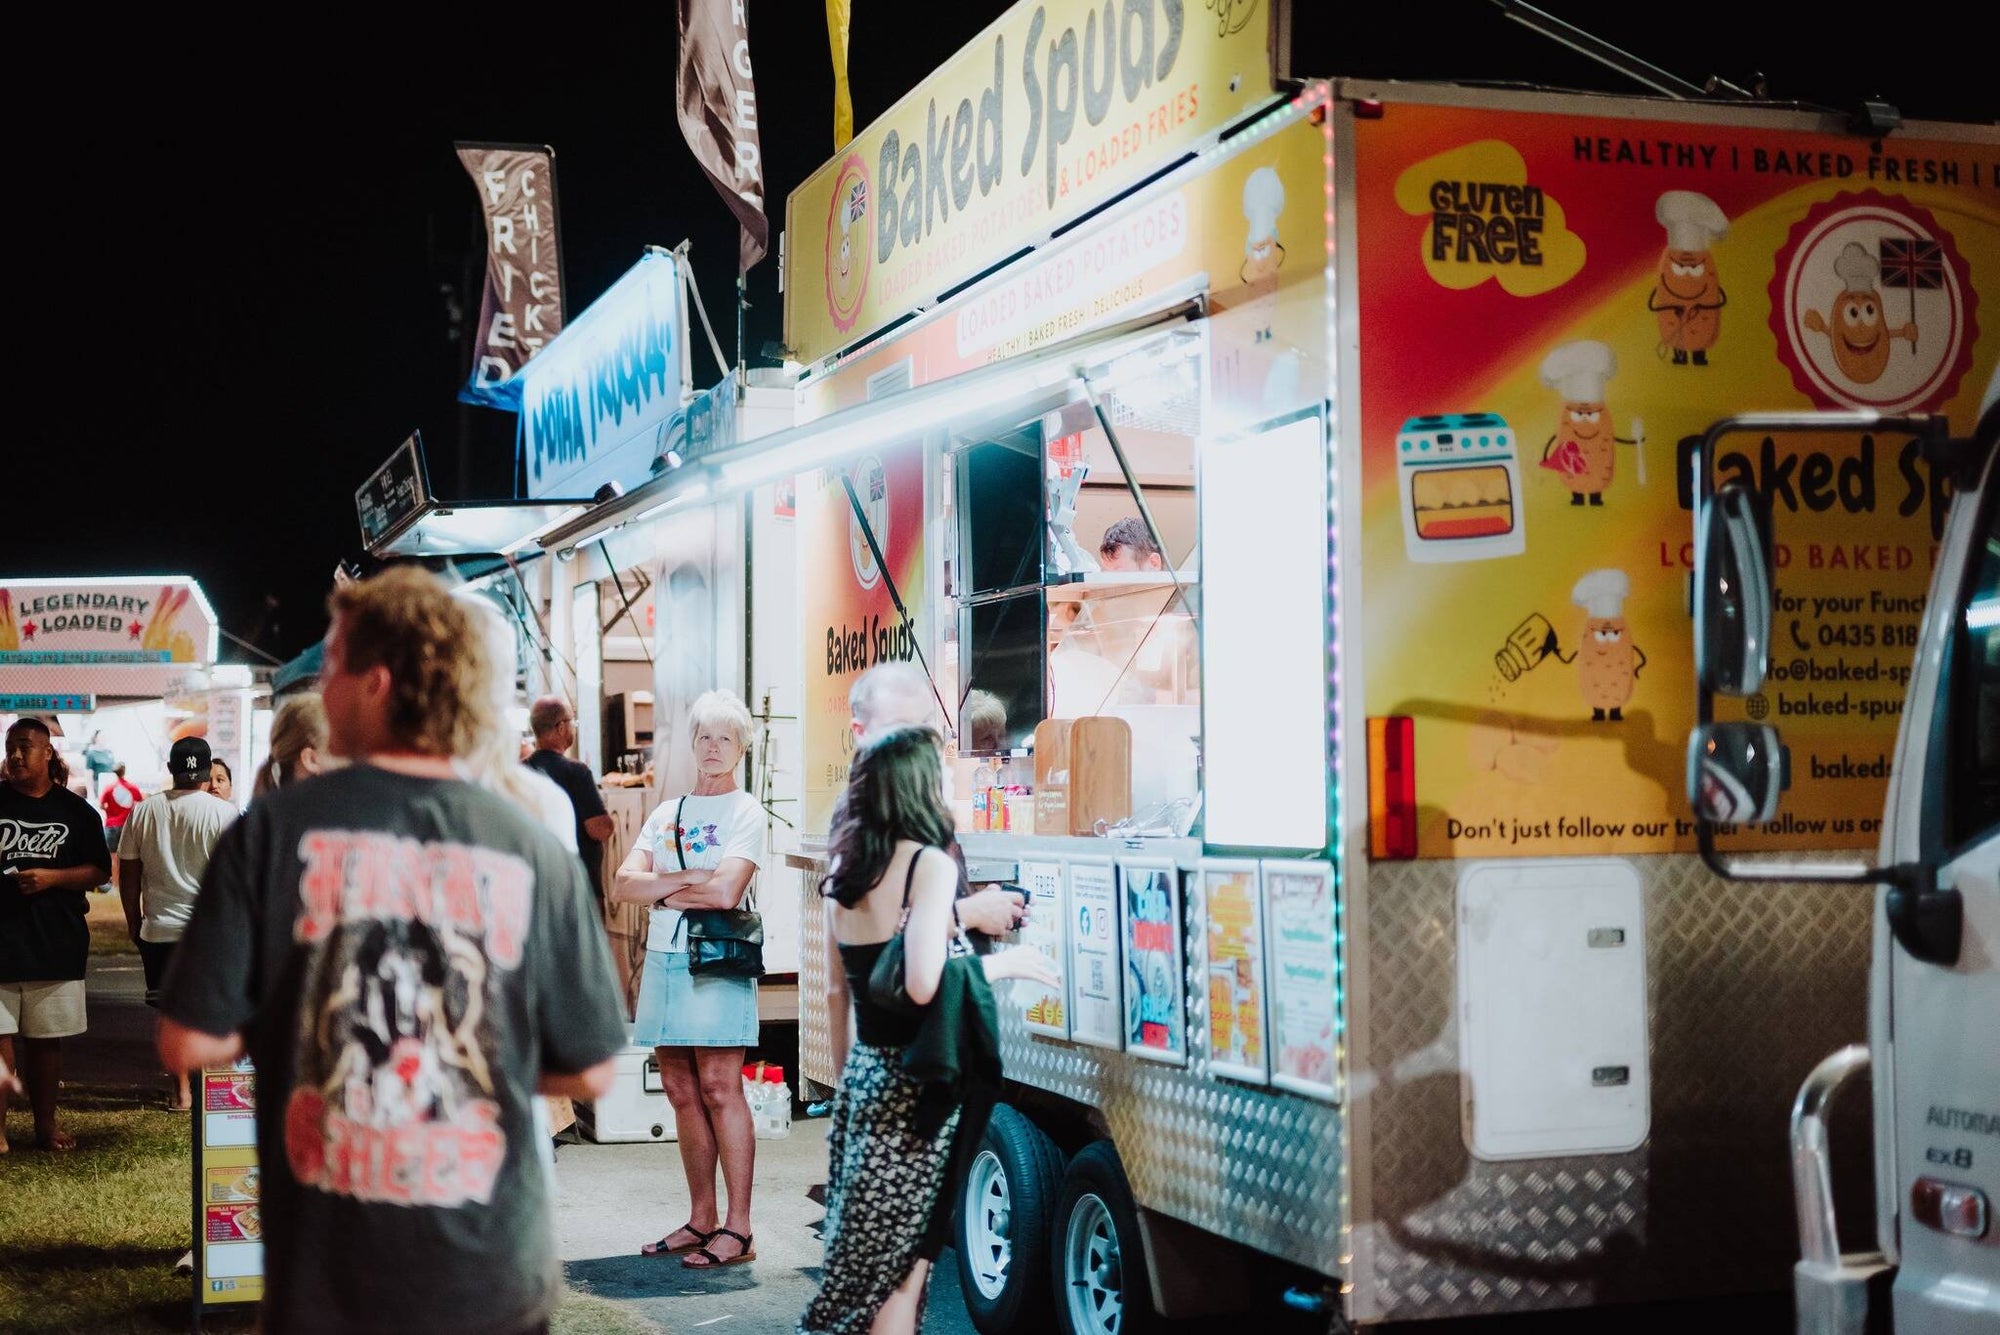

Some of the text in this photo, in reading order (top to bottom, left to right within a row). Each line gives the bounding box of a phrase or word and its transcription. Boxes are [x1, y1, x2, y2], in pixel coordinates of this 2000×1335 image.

[877, 34, 1005, 264] Baked
[1075, 122, 1143, 188] LOADED
[1147, 83, 1200, 146] FRIES
[1573, 136, 1717, 170] HEALTHY
[1754, 148, 1853, 180] BAKED
[1868, 154, 1959, 187] FRESH
[960, 201, 1181, 341] LOADED BAKED POTATOES
[1028, 319, 1055, 345] BAKED
[1094, 280, 1144, 315] DELICIOUS
[1808, 543, 1913, 571] BAKED
[20, 593, 150, 617] LEGENDARY
[41, 614, 124, 634] LOADED
[1774, 593, 1808, 613] for
[1812, 597, 1863, 618] your
[826, 615, 868, 676] Baked
[1818, 624, 1918, 647] 0435 818
[1447, 817, 1507, 840] Don't
[1510, 817, 1552, 844] just
[1557, 815, 1625, 839] follow
[1632, 820, 1668, 838] our
[1831, 817, 1856, 834] us
